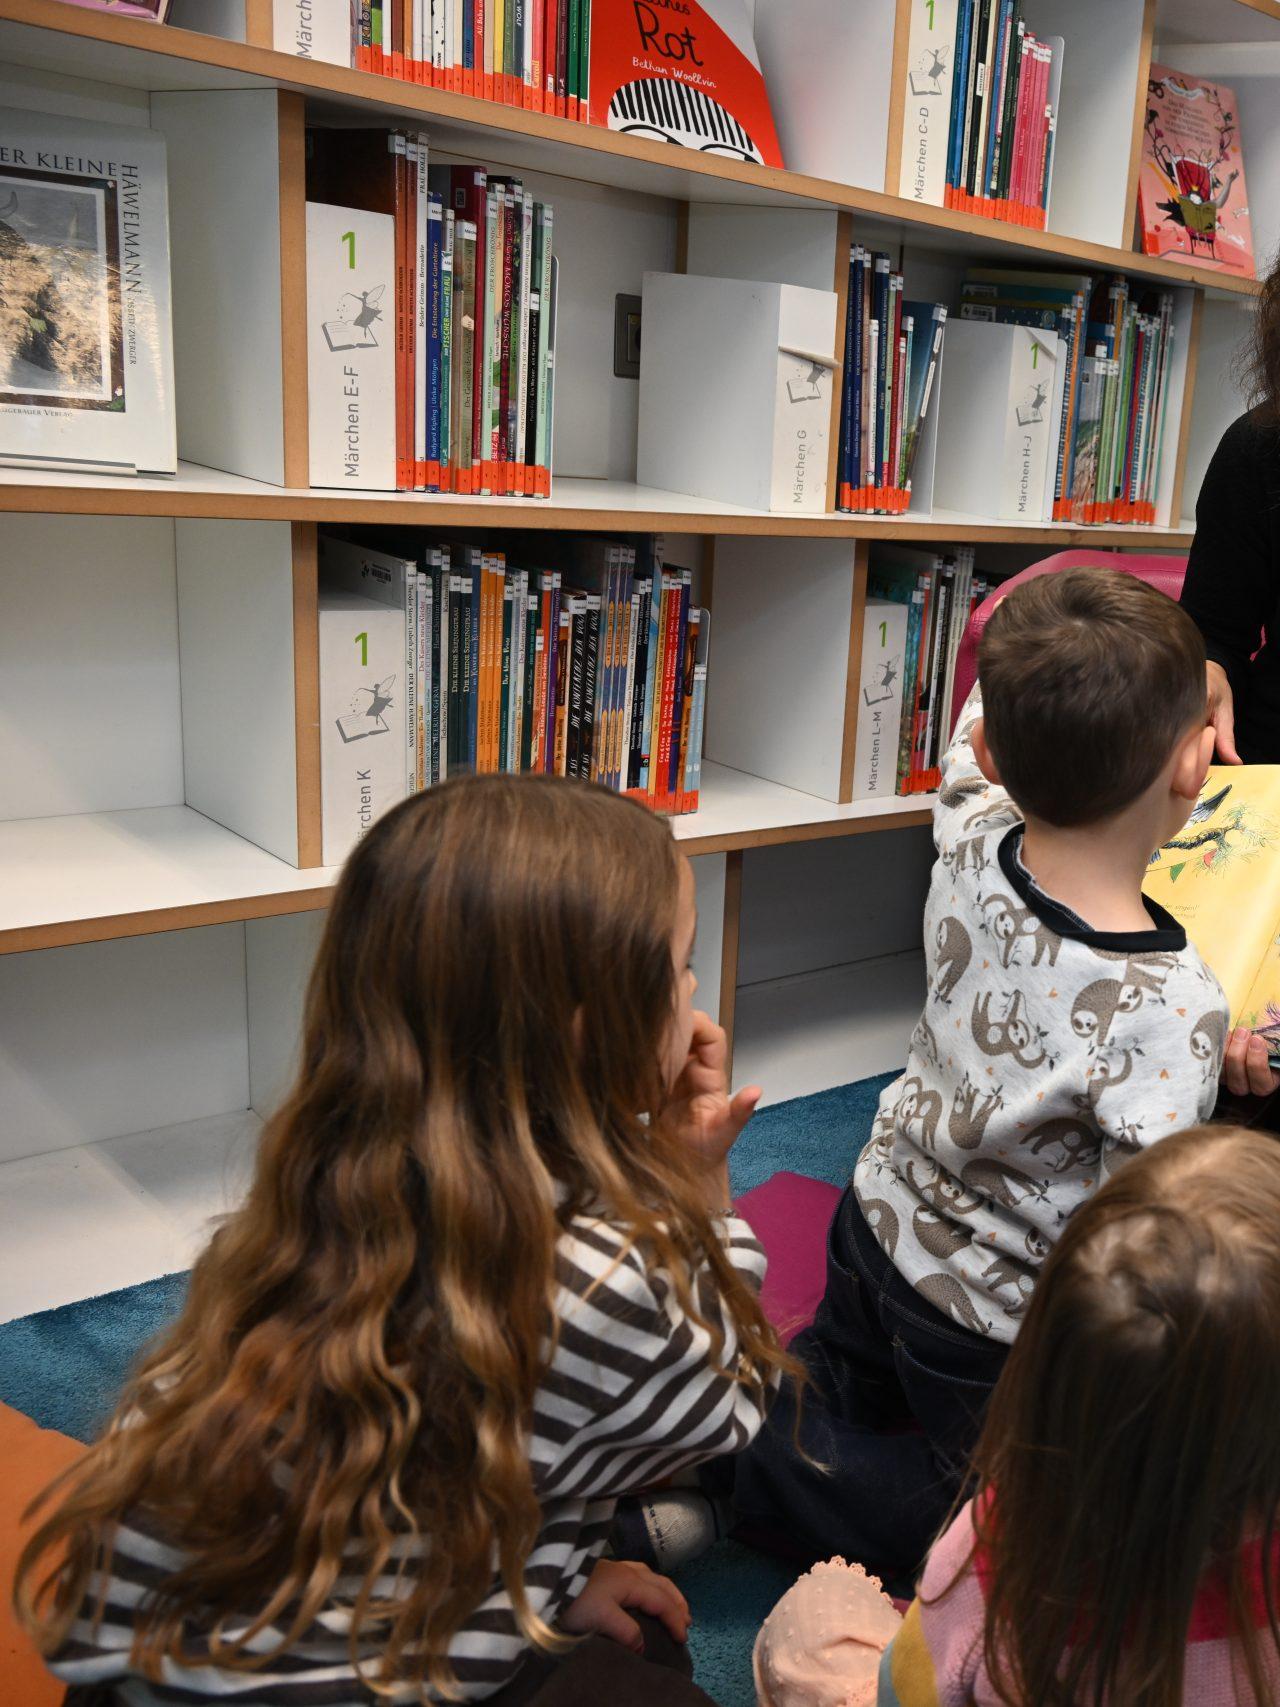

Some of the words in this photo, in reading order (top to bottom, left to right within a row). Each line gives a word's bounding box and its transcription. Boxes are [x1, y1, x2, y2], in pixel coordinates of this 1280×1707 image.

[298, 0, 313, 59] Märch
[925, 0, 934, 31] 1
[633, 0, 704, 67] Rot
[632, 56, 668, 75] Bethan
[671, 67, 717, 88] Woollvin
[918, 107, 929, 134] C-D
[0, 148, 28, 164] ER
[37, 152, 117, 177] KLEINE
[914, 138, 928, 200] Märchen
[121, 164, 142, 295] HÄWELMANN
[341, 231, 356, 269] 1
[504, 267, 512, 309] MOMOS
[1031, 342, 1038, 370] 1
[344, 365, 359, 397] E-F
[344, 403, 360, 478] Märchen
[796, 429, 806, 439] G
[1022, 435, 1032, 458] H-J
[793, 444, 806, 504] Märchen
[1017, 460, 1031, 513] Märchen
[355, 632, 368, 667] 1
[588, 636, 597, 652] DER
[878, 620, 887, 648] 1
[572, 658, 582, 710] KONFERENZ
[584, 654, 595, 704] KONFERENZ
[584, 710, 592, 723] DIE
[872, 711, 882, 736] L-M
[356, 769, 371, 780] K
[868, 738, 881, 791] Märchen
[356, 785, 371, 848] ärchen
